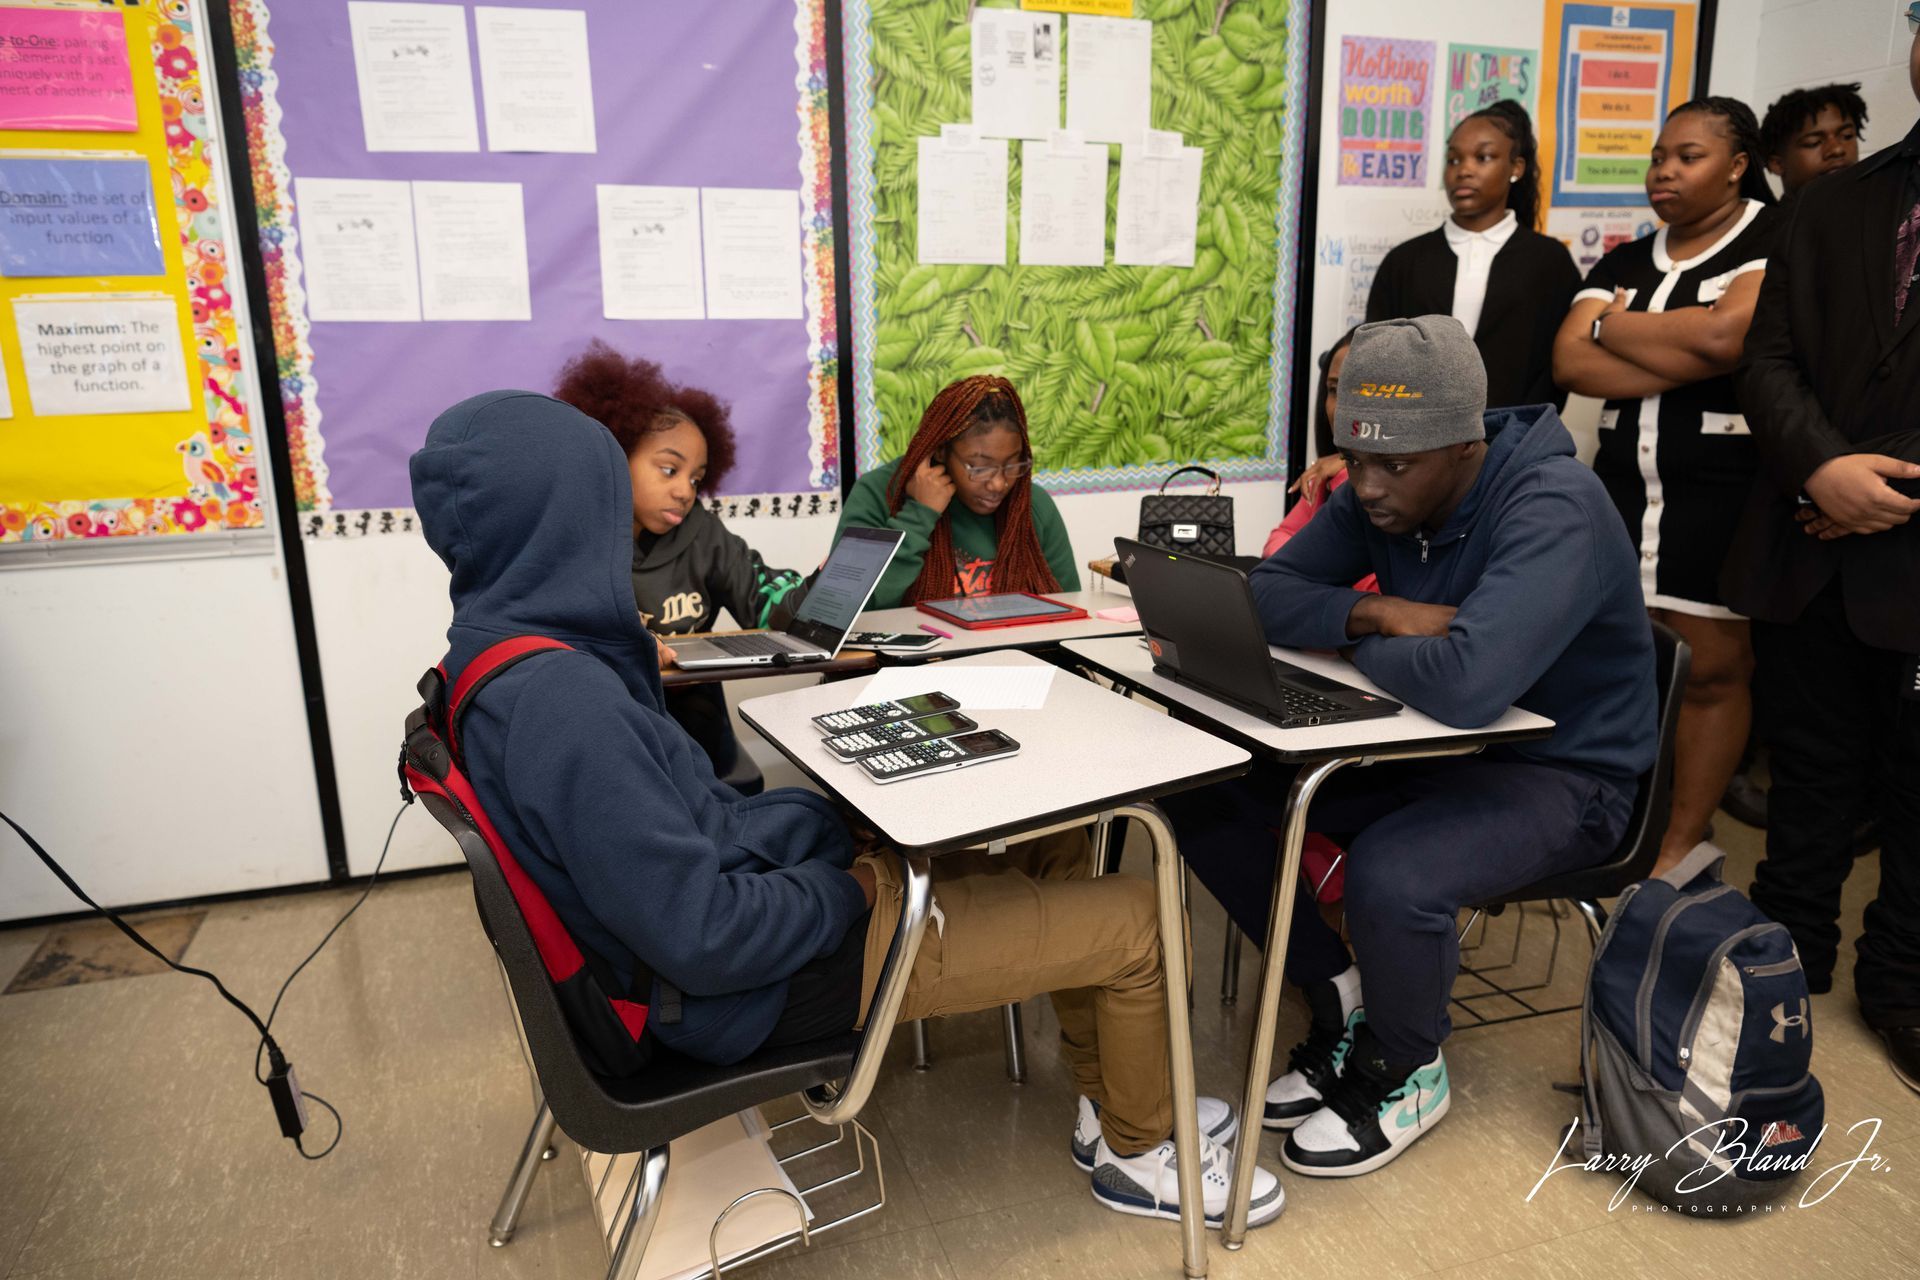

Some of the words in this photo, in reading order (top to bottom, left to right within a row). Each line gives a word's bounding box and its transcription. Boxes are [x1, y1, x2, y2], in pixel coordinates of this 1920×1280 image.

[70, 52, 82, 64] of
[87, 56, 94, 64] a
[98, 55, 117, 65] set
[56, 70, 84, 80] with
[89, 72, 103, 81] an
[1342, 39, 1429, 106] Nothing
[1450, 51, 1530, 95] MISTAKES
[35, 85, 48, 96] of
[52, 86, 102, 97] another
[1345, 81, 1412, 106] worth
[1478, 81, 1501, 106] ARE
[1342, 107, 1424, 140] DOING
[1361, 153, 1422, 180] EASY
[0, 190, 67, 206] Domain:
[71, 191, 97, 205] the
[103, 192, 126, 206] set
[130, 191, 146, 206] of
[10, 212, 54, 227] input
[60, 211, 108, 225] values
[113, 210, 128, 225] of
[134, 214, 143, 225] a
[46, 230, 114, 244] function
[37, 323, 127, 336] Maximum:
[131, 321, 159, 334] The
[37, 342, 96, 357] highest
[101, 342, 142, 355] point
[146, 342, 166, 353] on
[50, 361, 77, 374] the
[82, 360, 127, 376] graph
[131, 359, 147, 371] of
[152, 361, 161, 371] a
[74, 379, 144, 393] function.
[660, 592, 703, 624] me
